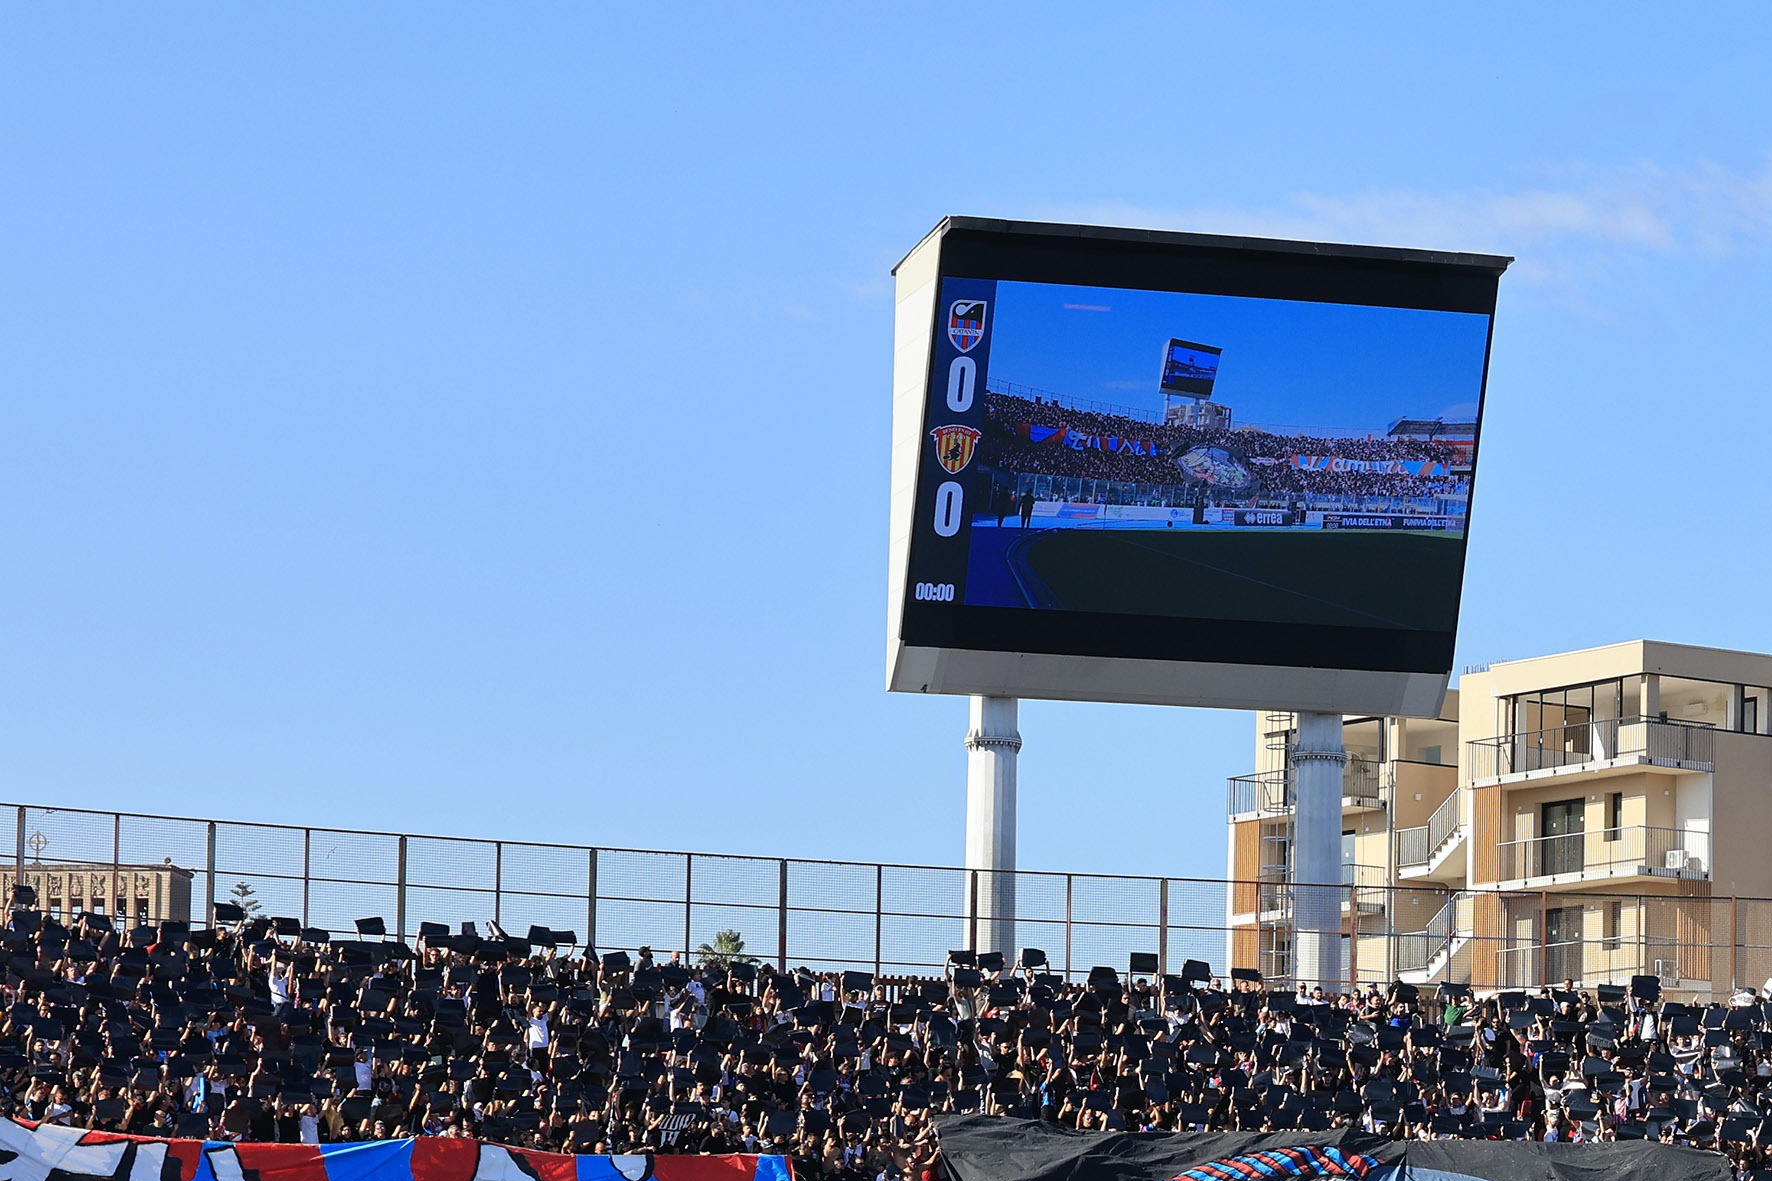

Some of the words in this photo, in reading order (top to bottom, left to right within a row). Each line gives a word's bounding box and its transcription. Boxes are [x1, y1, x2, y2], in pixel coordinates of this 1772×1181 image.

[946, 356, 977, 413] 0
[933, 480, 965, 538] 0
[915, 582, 956, 603] 00:00
